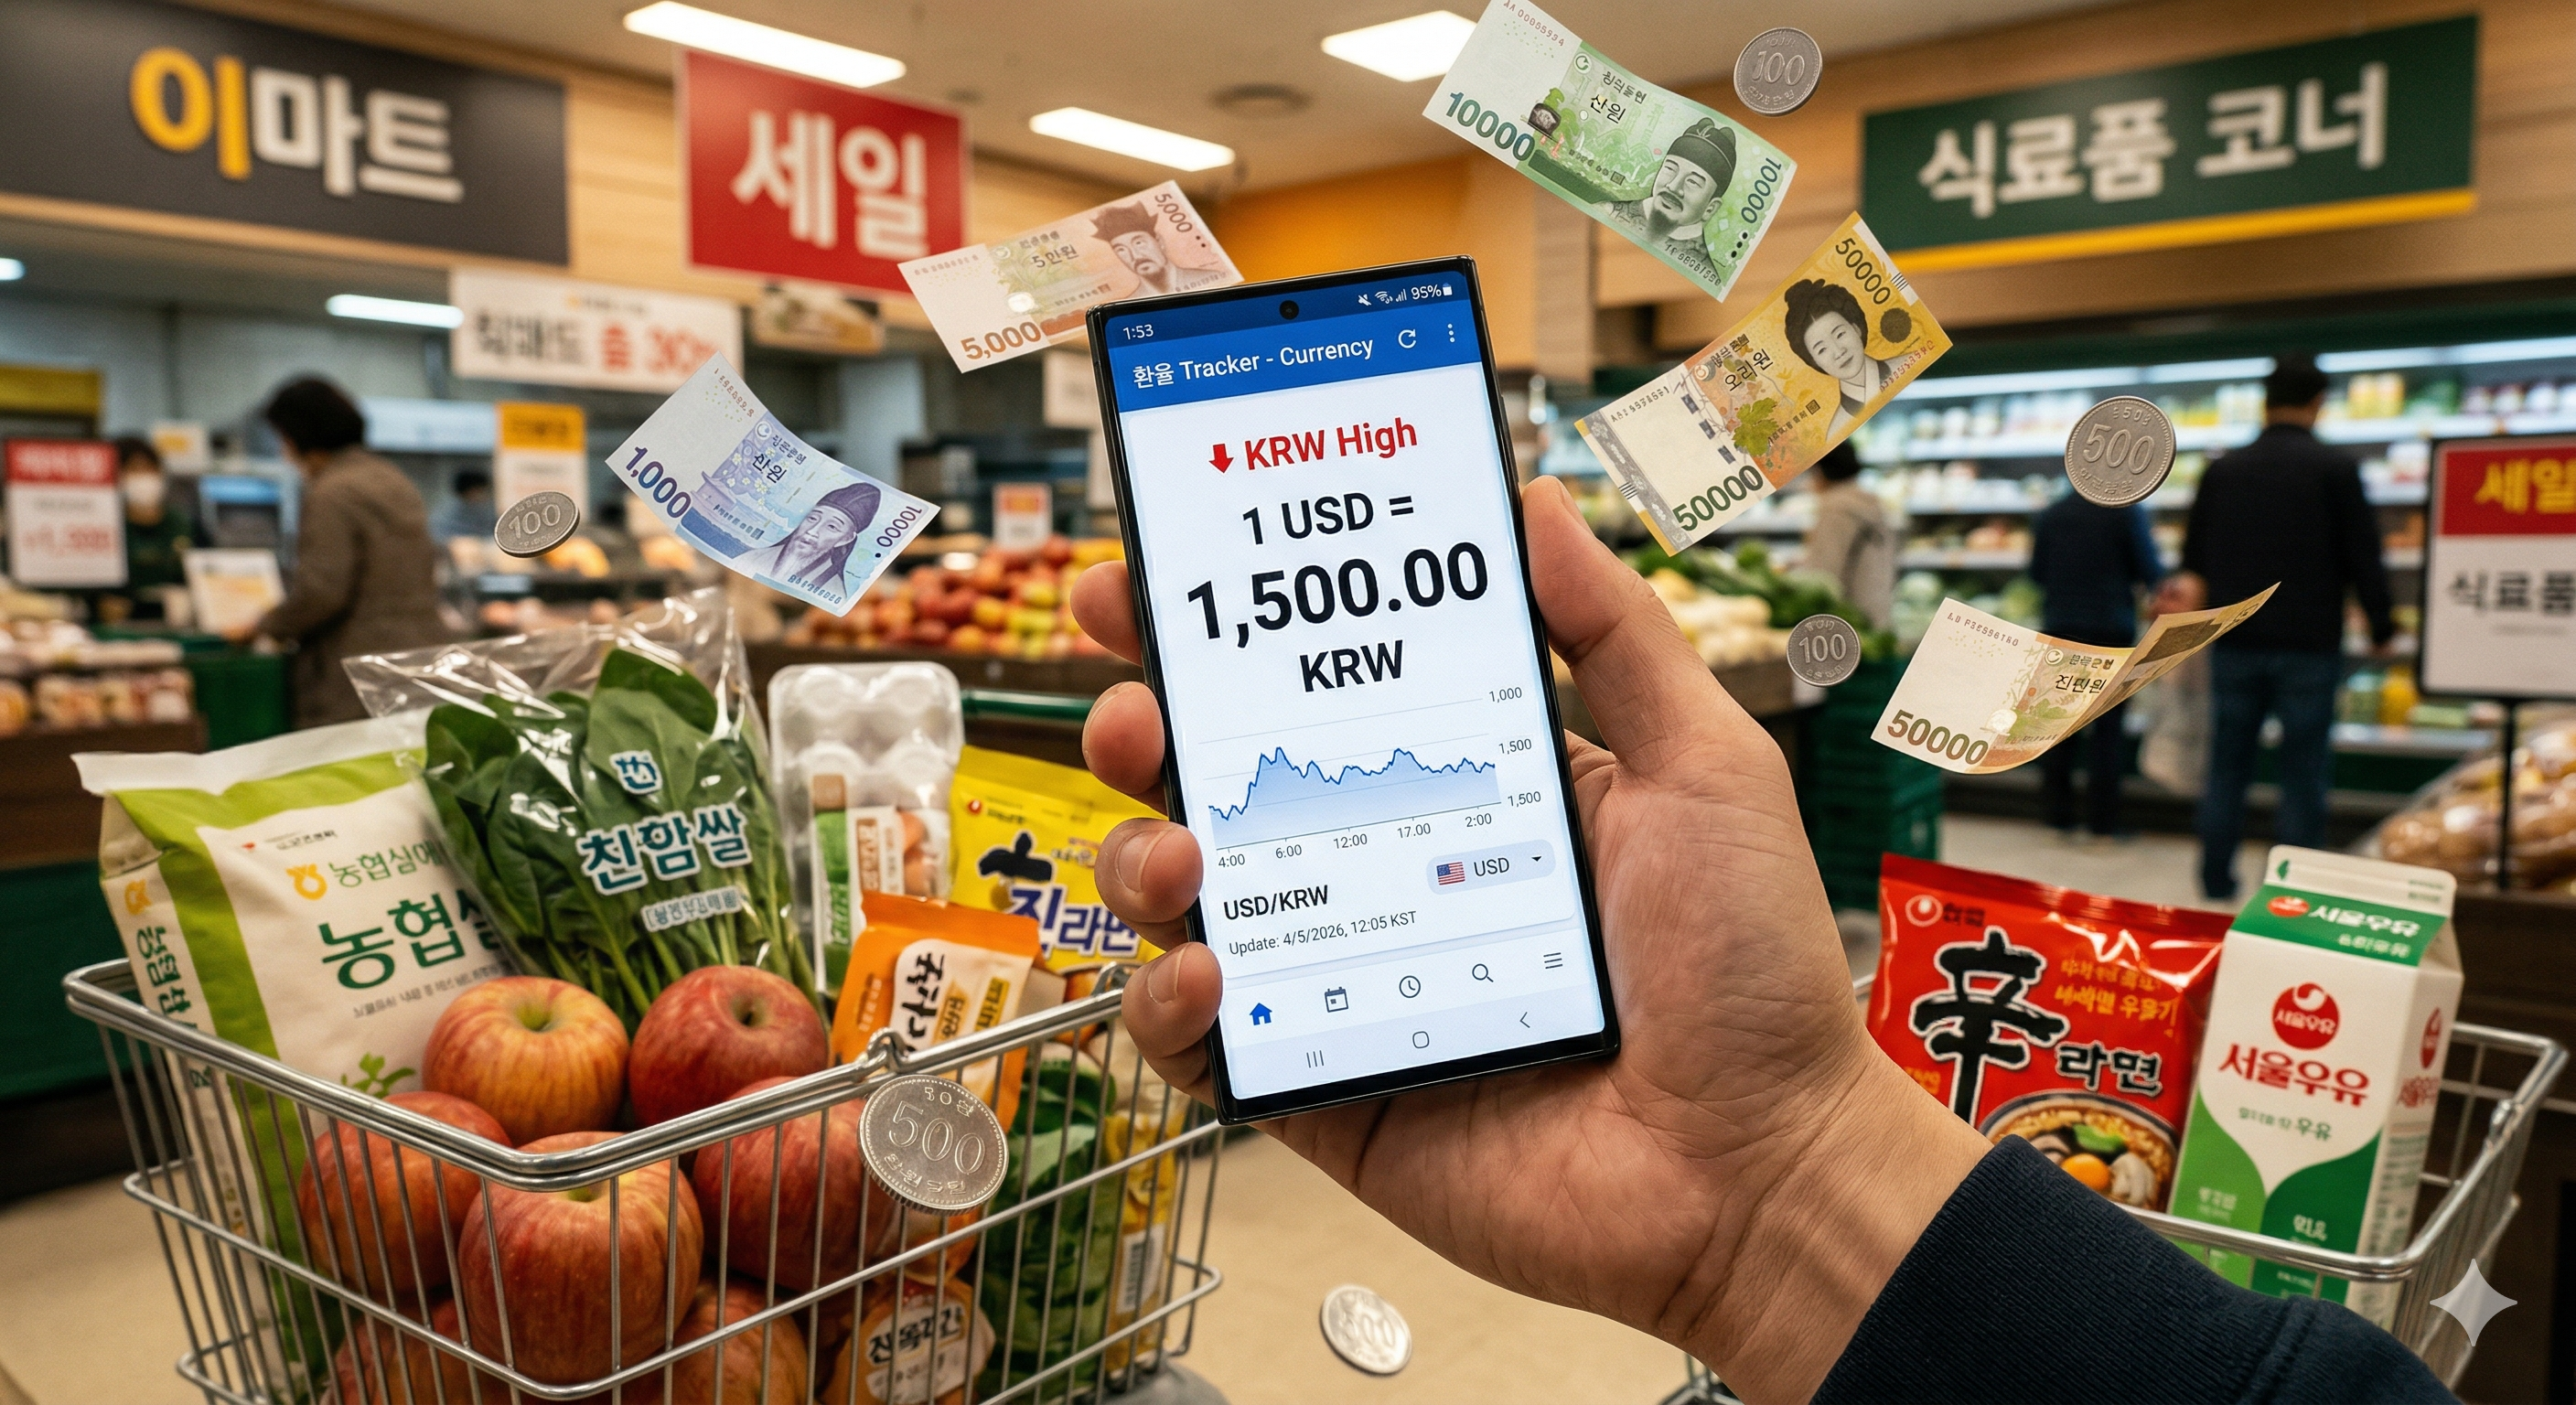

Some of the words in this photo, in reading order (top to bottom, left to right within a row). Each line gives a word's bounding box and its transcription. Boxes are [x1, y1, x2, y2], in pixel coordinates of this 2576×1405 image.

[1752, 50, 1805, 86] 100
[130, 47, 464, 202] 이마트
[1444, 90, 1536, 163] 10000
[1916, 98, 2176, 219] 식료품
[2196, 61, 2388, 177] 코너
[731, 110, 928, 261] 세일
[1741, 156, 1782, 224] 10000
[1154, 192, 1193, 234] 5,000
[1410, 284, 1442, 301] 95%
[1835, 237, 1891, 306] 50000
[960, 321, 1042, 361] 5,000
[1122, 323, 1154, 340] 1:53
[1132, 362, 1175, 390] 환율
[1179, 351, 1261, 381] Tracker
[1280, 337, 1374, 367] Currency
[1245, 429, 1326, 471] KRW
[1337, 417, 1418, 459] High
[2083, 424, 2155, 476] 500
[624, 445, 692, 520] 1,000
[1672, 465, 1764, 532] 50000
[2474, 458, 2576, 515] 세일
[508, 503, 561, 540] 100
[1242, 508, 1264, 545] 1
[1282, 492, 1374, 540] USD
[1389, 495, 1415, 517] =
[1187, 541, 1488, 649] 1,500.00
[2447, 568, 2575, 618] 식료품
[1299, 639, 1403, 692] KRW
[1798, 633, 1847, 664] 100
[1488, 687, 1523, 705] 1,000
[1497, 737, 1533, 756] 1,500
[1886, 709, 1990, 767] 50000
[1465, 812, 1493, 829] 2:00
[1507, 790, 1542, 809] 1,500
[580, 808, 748, 891] 친함쌀
[1218, 853, 1246, 869] 4:00
[1274, 843, 1303, 860] 6:00
[1333, 833, 1368, 851] 12:00
[1473, 856, 1511, 878] USD
[1223, 885, 1329, 921] USD/KRW
[2307, 904, 2421, 938] 서울우유
[1229, 934, 1281, 958] Update:
[1283, 924, 1348, 948] 4/5/2026,
[1350, 916, 1388, 935] 12:05
[1390, 910, 1417, 928] KST
[1912, 929, 2066, 1126] 辛
[2059, 1044, 2161, 1094] 라면
[2218, 1043, 2370, 1108] 서울우유
[888, 1100, 986, 1175] 500
[2296, 1117, 2332, 1142] 우유
